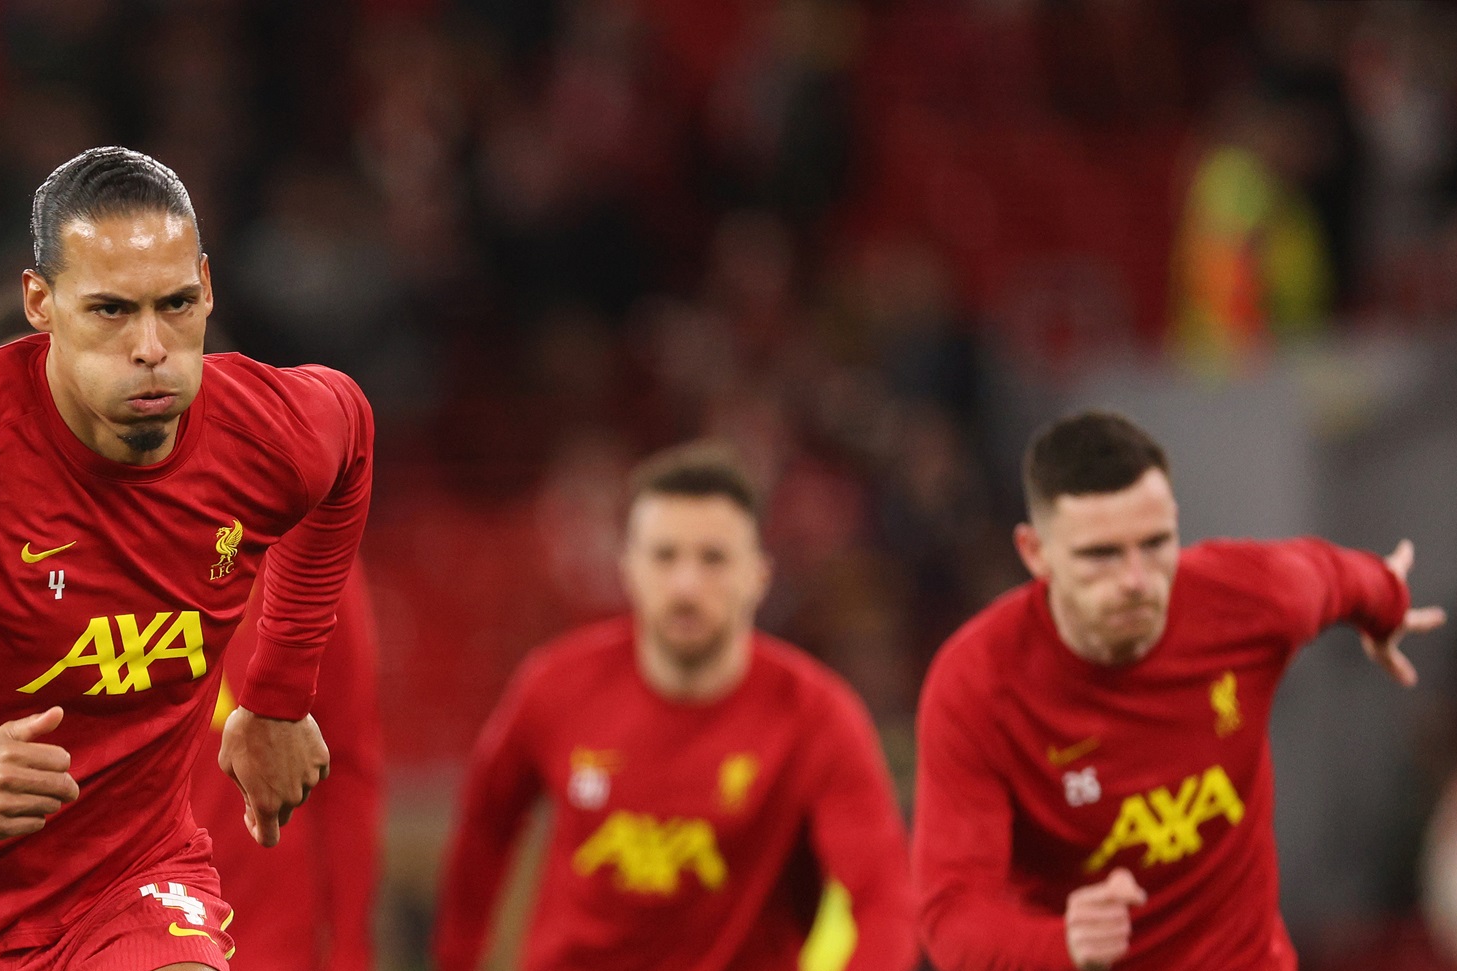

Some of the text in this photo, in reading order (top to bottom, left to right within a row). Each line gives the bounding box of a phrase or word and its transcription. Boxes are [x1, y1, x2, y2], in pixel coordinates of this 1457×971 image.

[48, 569, 66, 600] 4
[16, 610, 207, 695] AXA
[1084, 765, 1245, 873] AXA
[139, 881, 207, 926] 4
